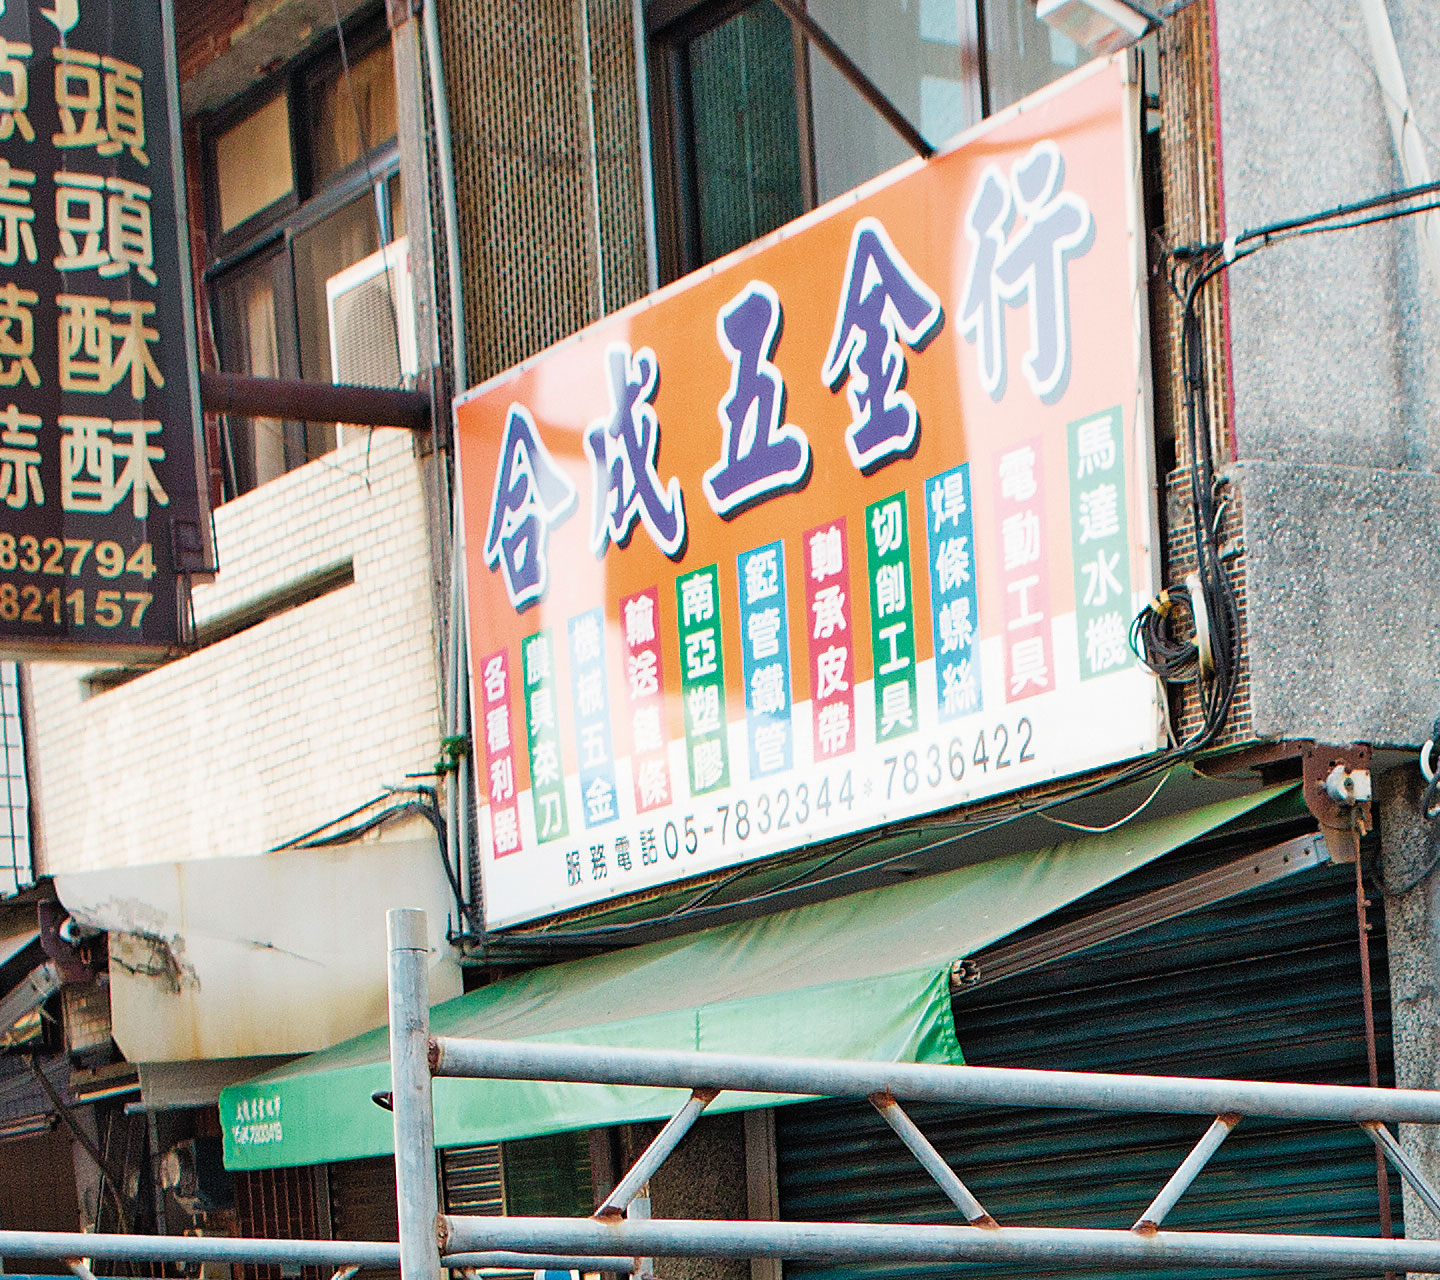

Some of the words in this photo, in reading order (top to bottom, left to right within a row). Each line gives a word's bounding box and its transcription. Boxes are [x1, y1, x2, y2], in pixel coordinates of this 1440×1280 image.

[484, 139, 1094, 612] 合成五金行
[808, 525, 852, 755] 軸承皮帶
[871, 501, 914, 736] 切削工具
[931, 474, 978, 714] 焊條螺絲
[998, 450, 1049, 695] 電動工具
[1075, 413, 1128, 673] 馬達水機
[483, 655, 518, 854] 各種利器
[526, 635, 562, 839] 農具菜刀
[573, 617, 615, 823] 機械五金
[681, 572, 724, 792] 南亞塑膠
[565, 828, 658, 887] 服務電話
[884, 716, 1036, 800] 7836422
